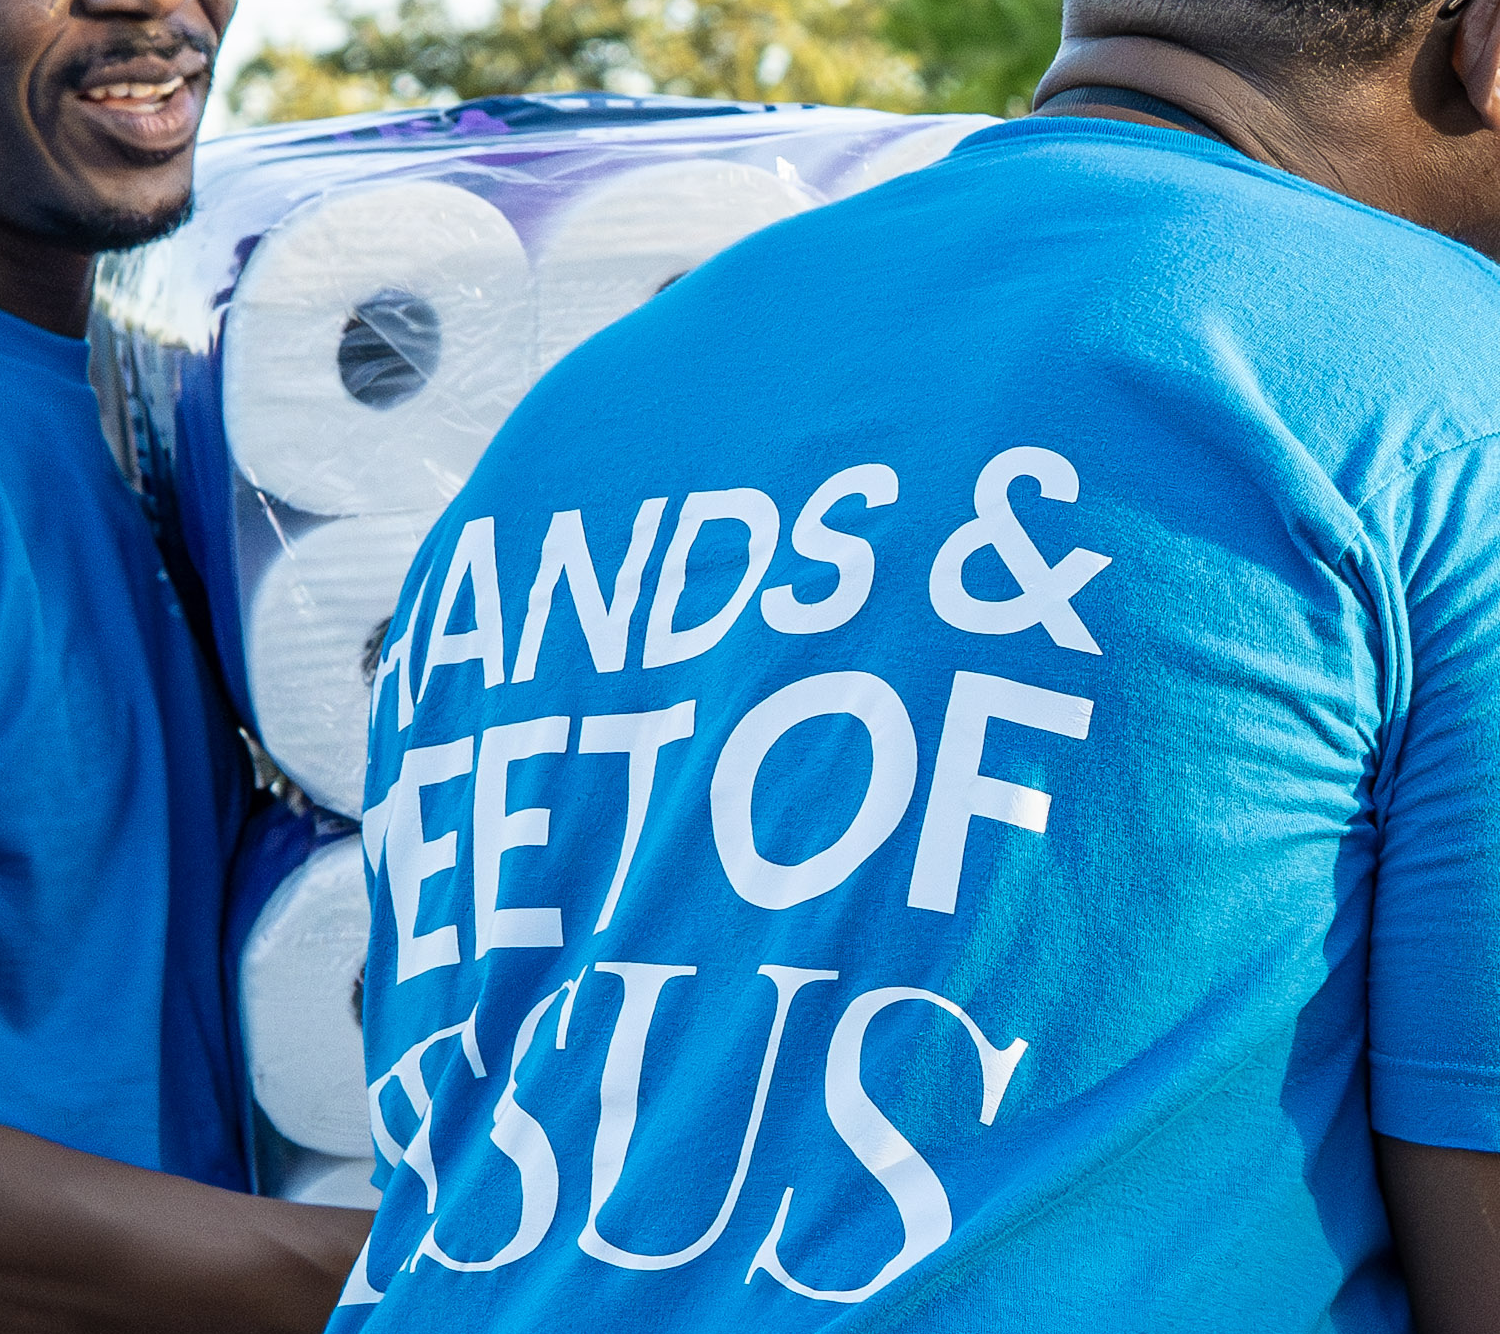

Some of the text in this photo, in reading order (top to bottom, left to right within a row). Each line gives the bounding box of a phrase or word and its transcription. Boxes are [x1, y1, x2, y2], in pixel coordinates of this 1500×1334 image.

[371, 445, 1113, 732] HANDS &
[710, 670, 1094, 915] OF
[337, 961, 1030, 1304] ESUS
